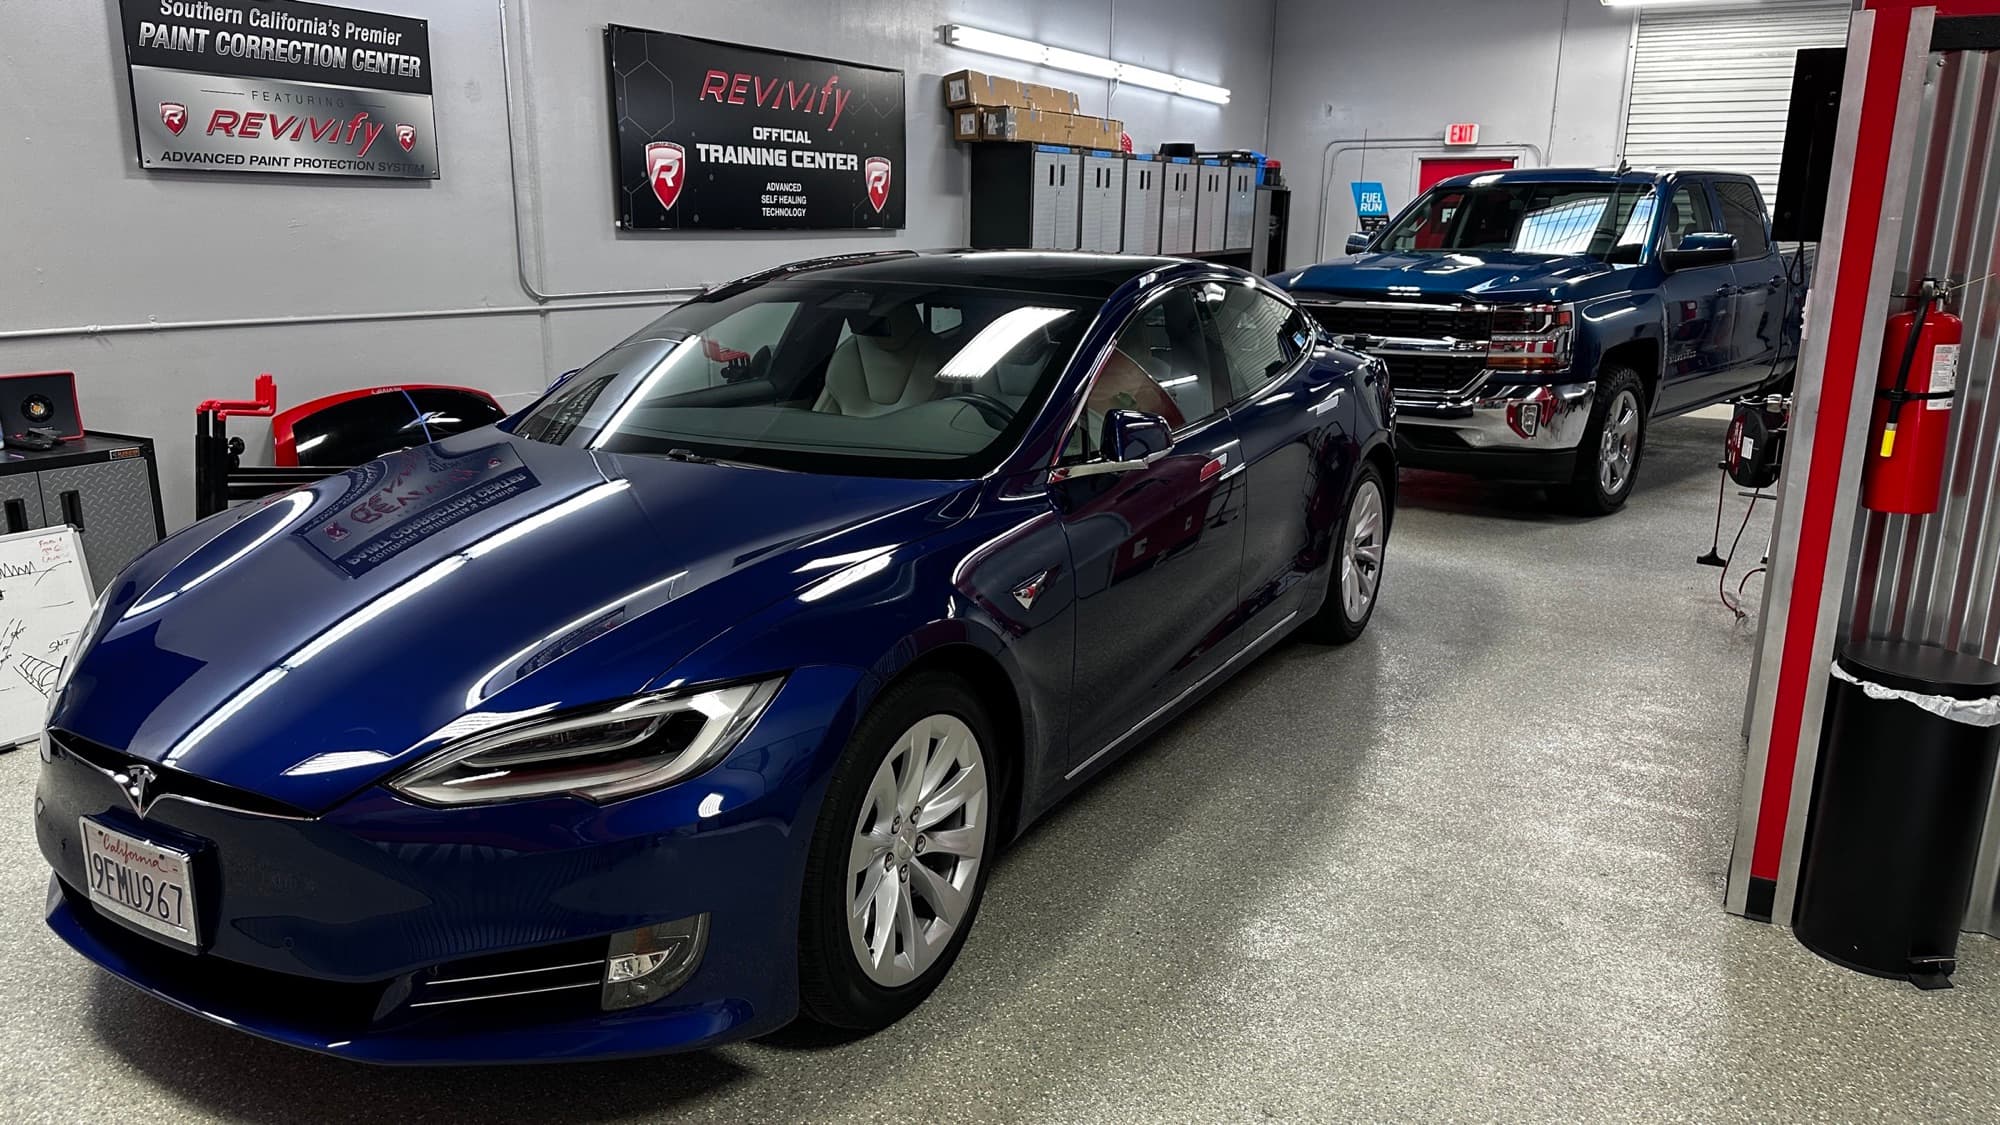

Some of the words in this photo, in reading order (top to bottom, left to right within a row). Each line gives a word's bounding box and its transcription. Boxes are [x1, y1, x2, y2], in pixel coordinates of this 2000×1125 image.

[160, 0, 243, 25] Southern
[249, 7, 340, 38] California's
[345, 22, 402, 47] Premier
[138, 22, 209, 52] PAINT
[215, 32, 347, 69] CORRECTION
[352, 49, 421, 78] CENTER
[251, 90, 345, 109] FEATURING
[753, 126, 811, 144] OFFICIAL
[1450, 124, 1475, 143] EXIT
[161, 151, 246, 166] ADVANCED
[249, 155, 291, 168] PAINT
[294, 157, 376, 171] PROTECTION
[378, 161, 425, 174] SYSTEM
[696, 143, 787, 167] TRAINING
[792, 151, 859, 171] CENTER
[766, 181, 802, 193] ADVANCED
[761, 194, 778, 205] SELF
[779, 195, 807, 205] HEALING
[1360, 202, 1382, 212] RUN
[1361, 192, 1382, 203] FUEL
[762, 206, 806, 217] TECHNOLOGY
[103, 834, 168, 873] California
[95, 853, 183, 925] 9FMU967
